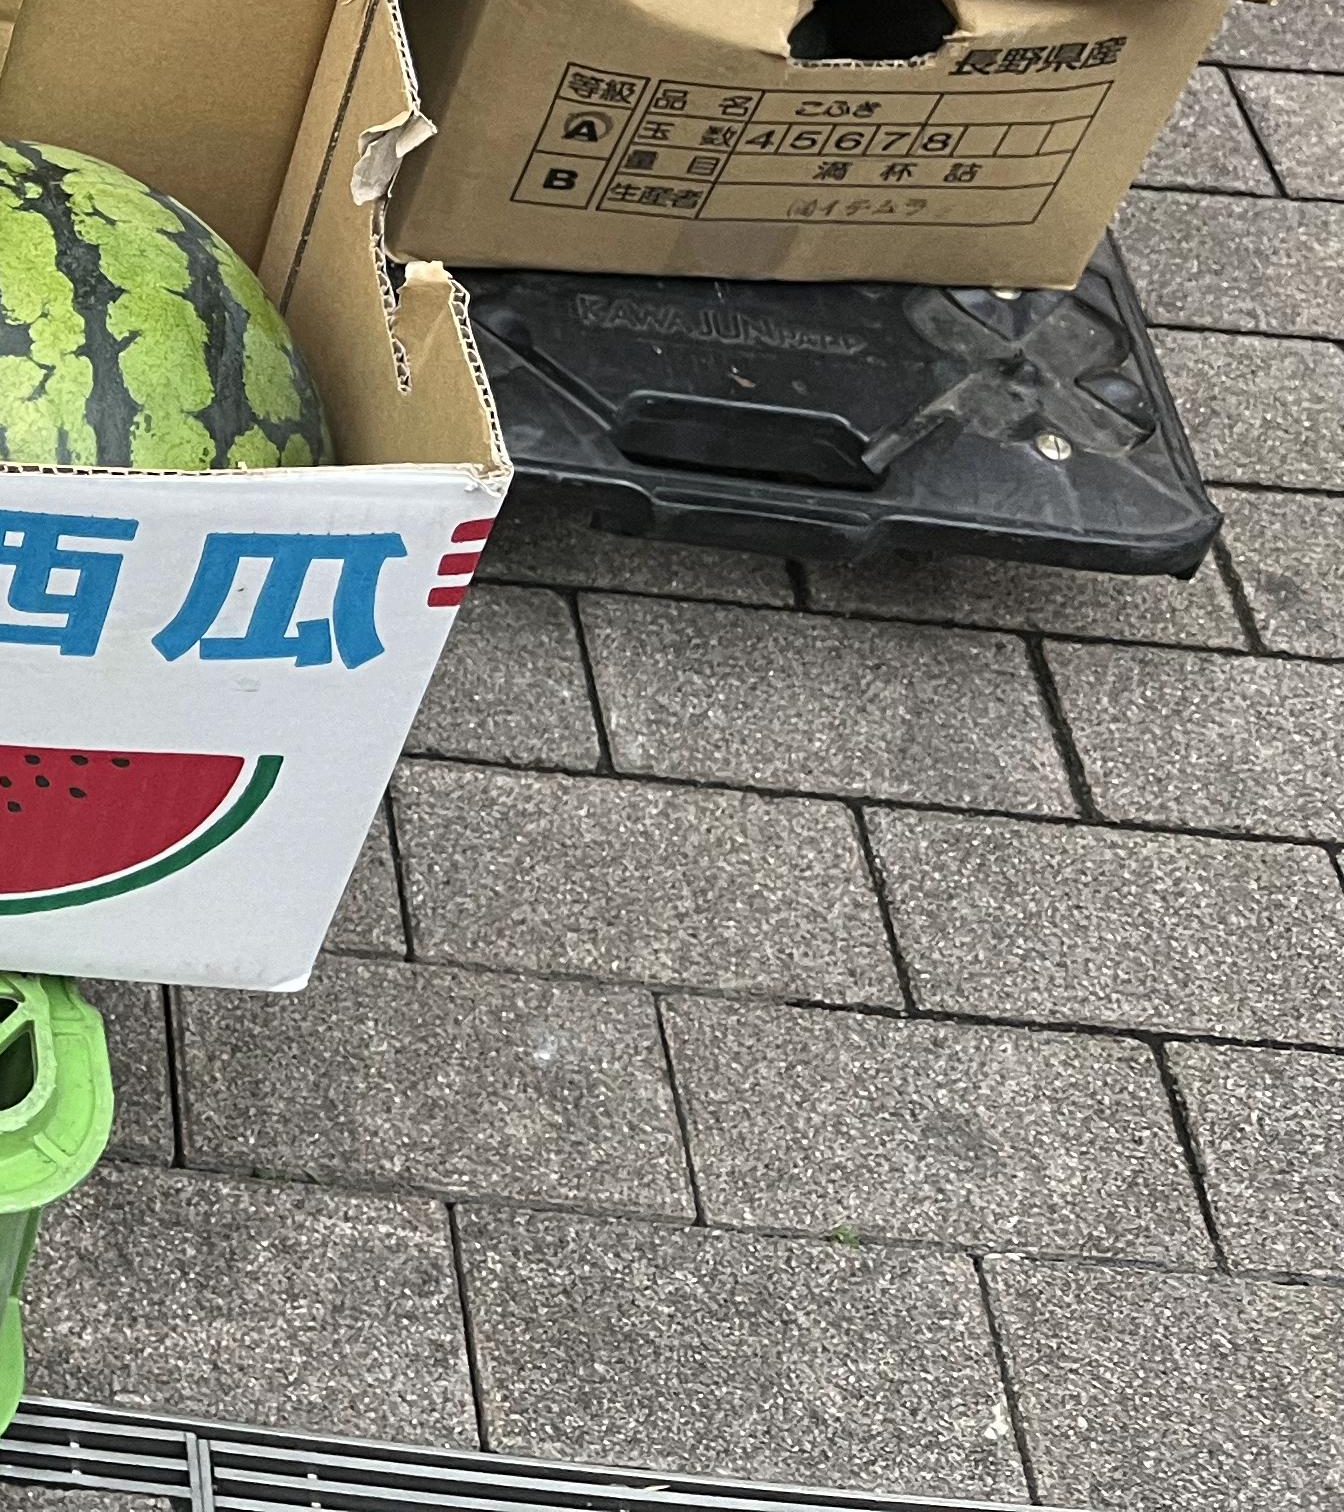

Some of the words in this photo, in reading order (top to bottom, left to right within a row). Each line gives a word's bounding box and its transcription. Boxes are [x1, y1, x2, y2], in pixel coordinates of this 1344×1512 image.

[949, 36, 1127, 76] 長野県産
[567, 71, 637, 105] 等級
[653, 89, 754, 117] 品名
[562, 119, 599, 142] A
[745, 129, 775, 150] 4
[789, 130, 823, 151] 5
[833, 130, 866, 151] 6
[879, 131, 912, 152] 7
[921, 131, 953, 152] 8
[543, 167, 578, 190] B
